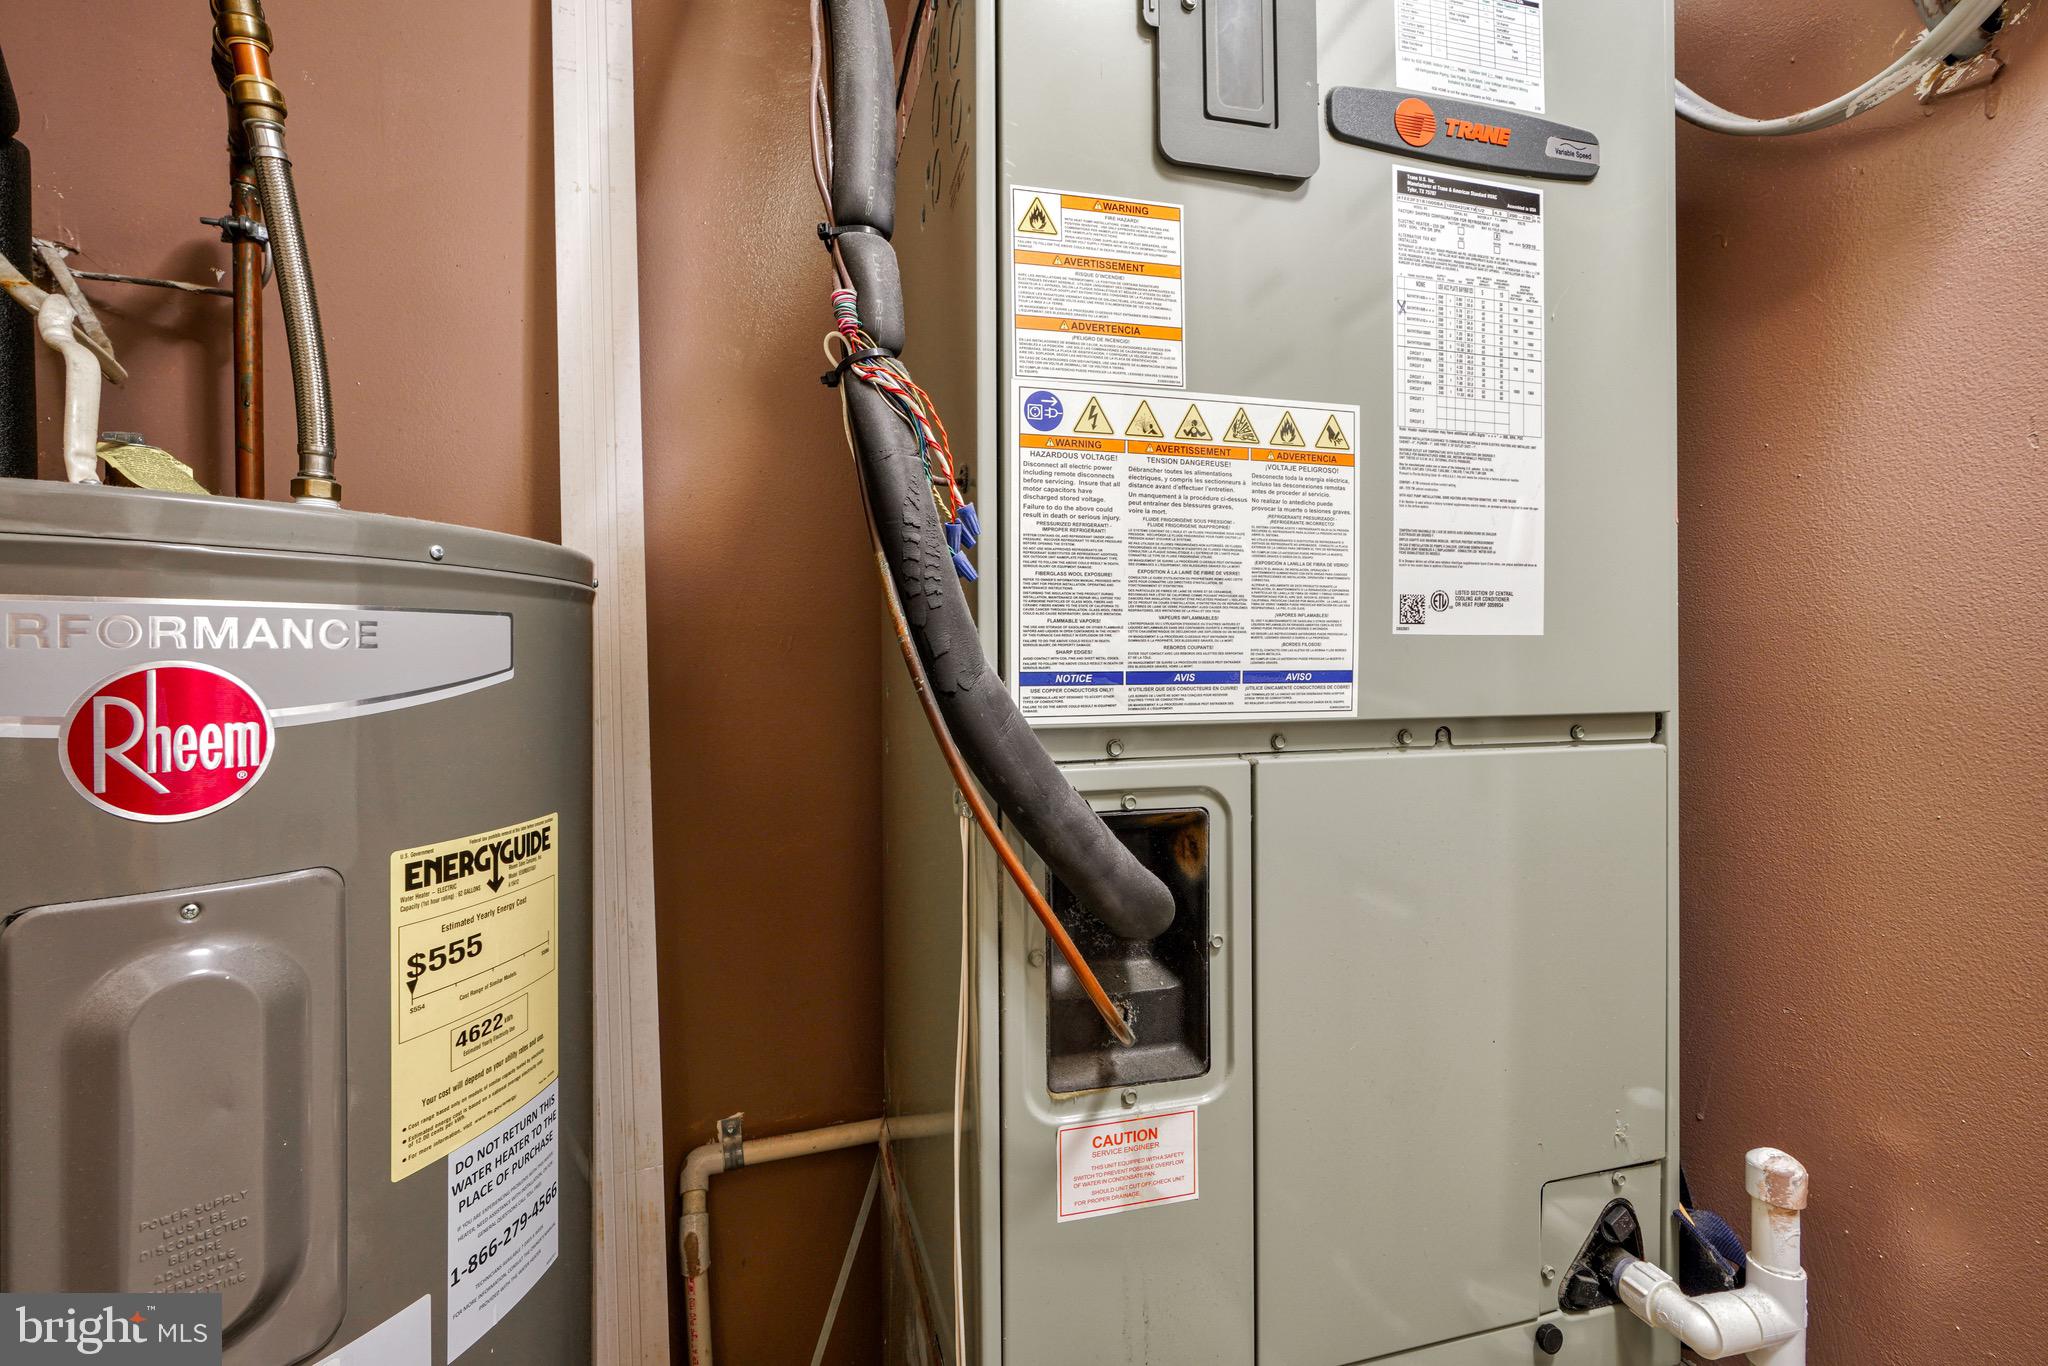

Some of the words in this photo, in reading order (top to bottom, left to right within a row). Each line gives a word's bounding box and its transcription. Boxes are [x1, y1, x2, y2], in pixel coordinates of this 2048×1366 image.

[1445, 118, 1511, 147] TRANE
[1555, 147, 1574, 158] Variable
[1576, 149, 1591, 160] Speed
[1103, 203, 1149, 215] WARNING
[1064, 257, 1144, 272] AVERTISSEMENT
[1071, 321, 1140, 335] ADVERTENCIA
[1030, 451, 1078, 459] HAZARDOUS
[1056, 439, 1101, 448] WARNING
[1156, 445, 1231, 456] AVERTISSEMENT
[1277, 453, 1337, 462] ADVERTENCIA
[1180, 459, 1231, 467] DANGEREUSE!
[6, 613, 378, 649] RFORMANCE
[1056, 674, 1092, 683] NOTICE
[93, 669, 259, 794] Rheem
[405, 826, 550, 892] ENERGYGUIDE
[400, 895, 414, 903] Water
[415, 891, 430, 900] Heater
[442, 917, 474, 932] Estimated
[477, 909, 495, 921] Yearly
[497, 902, 514, 914] Energy
[516, 897, 526, 906] Cost
[407, 933, 482, 980] $555
[456, 1013, 503, 1047] 4622
[422, 1095, 437, 1107] Your
[439, 1088, 451, 1098] cost
[453, 1082, 463, 1092] will
[465, 1071, 484, 1086] depend
[493, 1060, 504, 1071] your
[455, 1155, 473, 1175] DO
[477, 1137, 500, 1161] NOT
[503, 1109, 538, 1144] RETURN
[540, 1094, 555, 1114] THIS
[1092, 1128, 1158, 1148] CAUTION
[452, 1163, 492, 1196] WATER
[495, 1134, 529, 1168] HEATER
[531, 1124, 542, 1139] TO
[544, 1110, 556, 1128] THE
[1092, 1146, 1122, 1158] SERVICE
[1124, 1142, 1159, 1153] ENGINEER
[1155, 1160, 1184, 1168] OVERFLOW
[459, 1180, 493, 1213] PLACE
[496, 1168, 509, 1186] OF
[512, 1130, 553, 1174] PURCHASE
[139, 1209, 190, 1232] POWER
[195, 1189, 248, 1215] SUPPLY
[163, 1217, 204, 1240] MUST
[210, 1210, 228, 1224] BE
[140, 1216, 248, 1263] DISCONNECTED
[451, 1181, 557, 1287] 1-866-279-4566
[154, 1248, 236, 1285] ADJUSTING
[168, 1239, 222, 1266] BEFORE
[146, 1258, 244, 1294] ERMOSTAT
